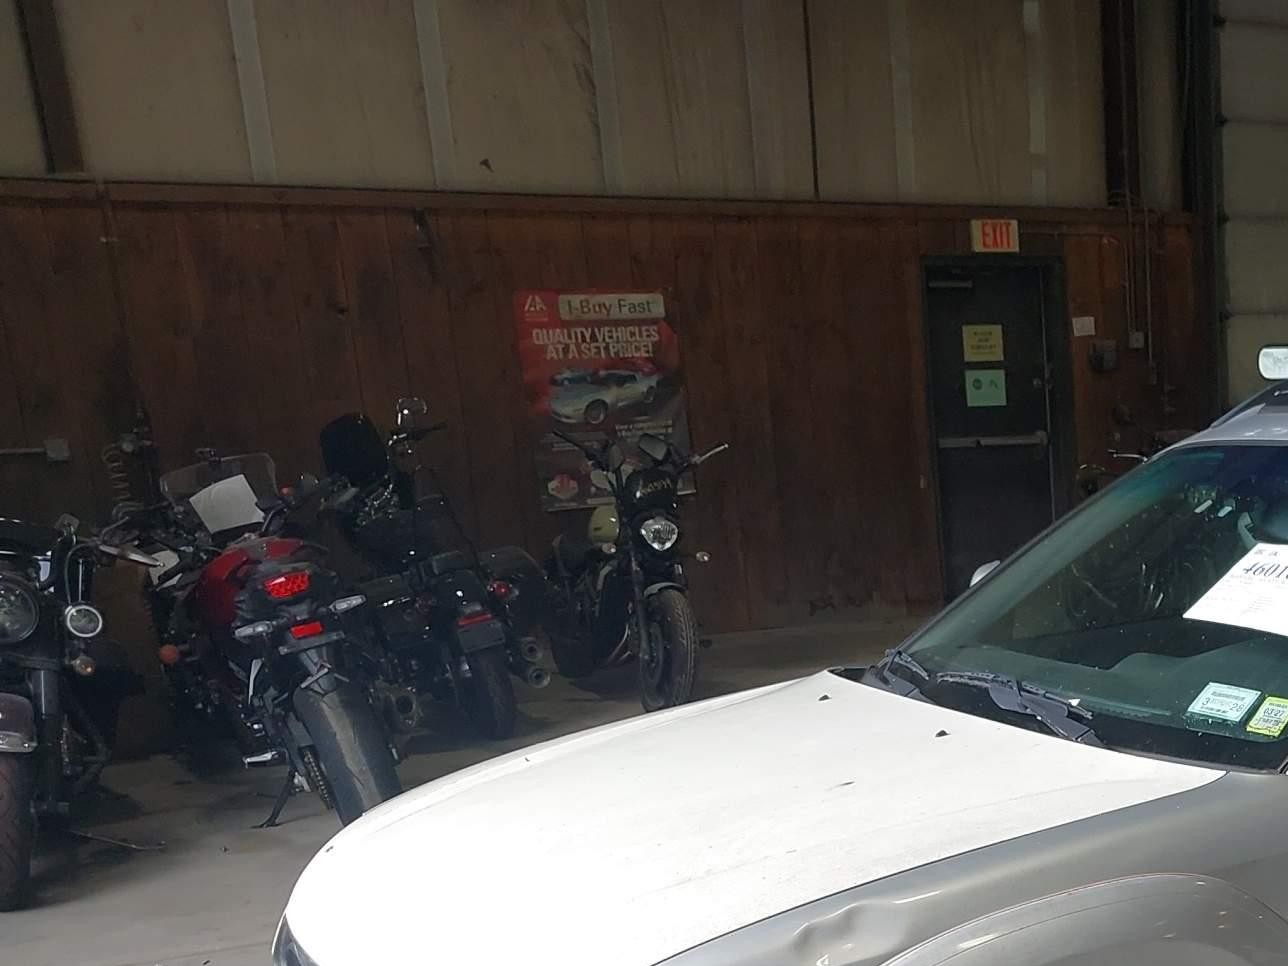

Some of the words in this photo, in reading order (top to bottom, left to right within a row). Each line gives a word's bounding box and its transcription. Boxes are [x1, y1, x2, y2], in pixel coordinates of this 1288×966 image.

[982, 222, 1011, 249] EXIT
[567, 298, 612, 317] I-Buy
[617, 297, 653, 315] Fast
[532, 327, 592, 345] QUALITY
[594, 325, 659, 343] VEHICLES
[545, 343, 565, 360] AT
[568, 343, 579, 360] A
[581, 342, 606, 359] SET
[609, 340, 654, 358] PRICE!
